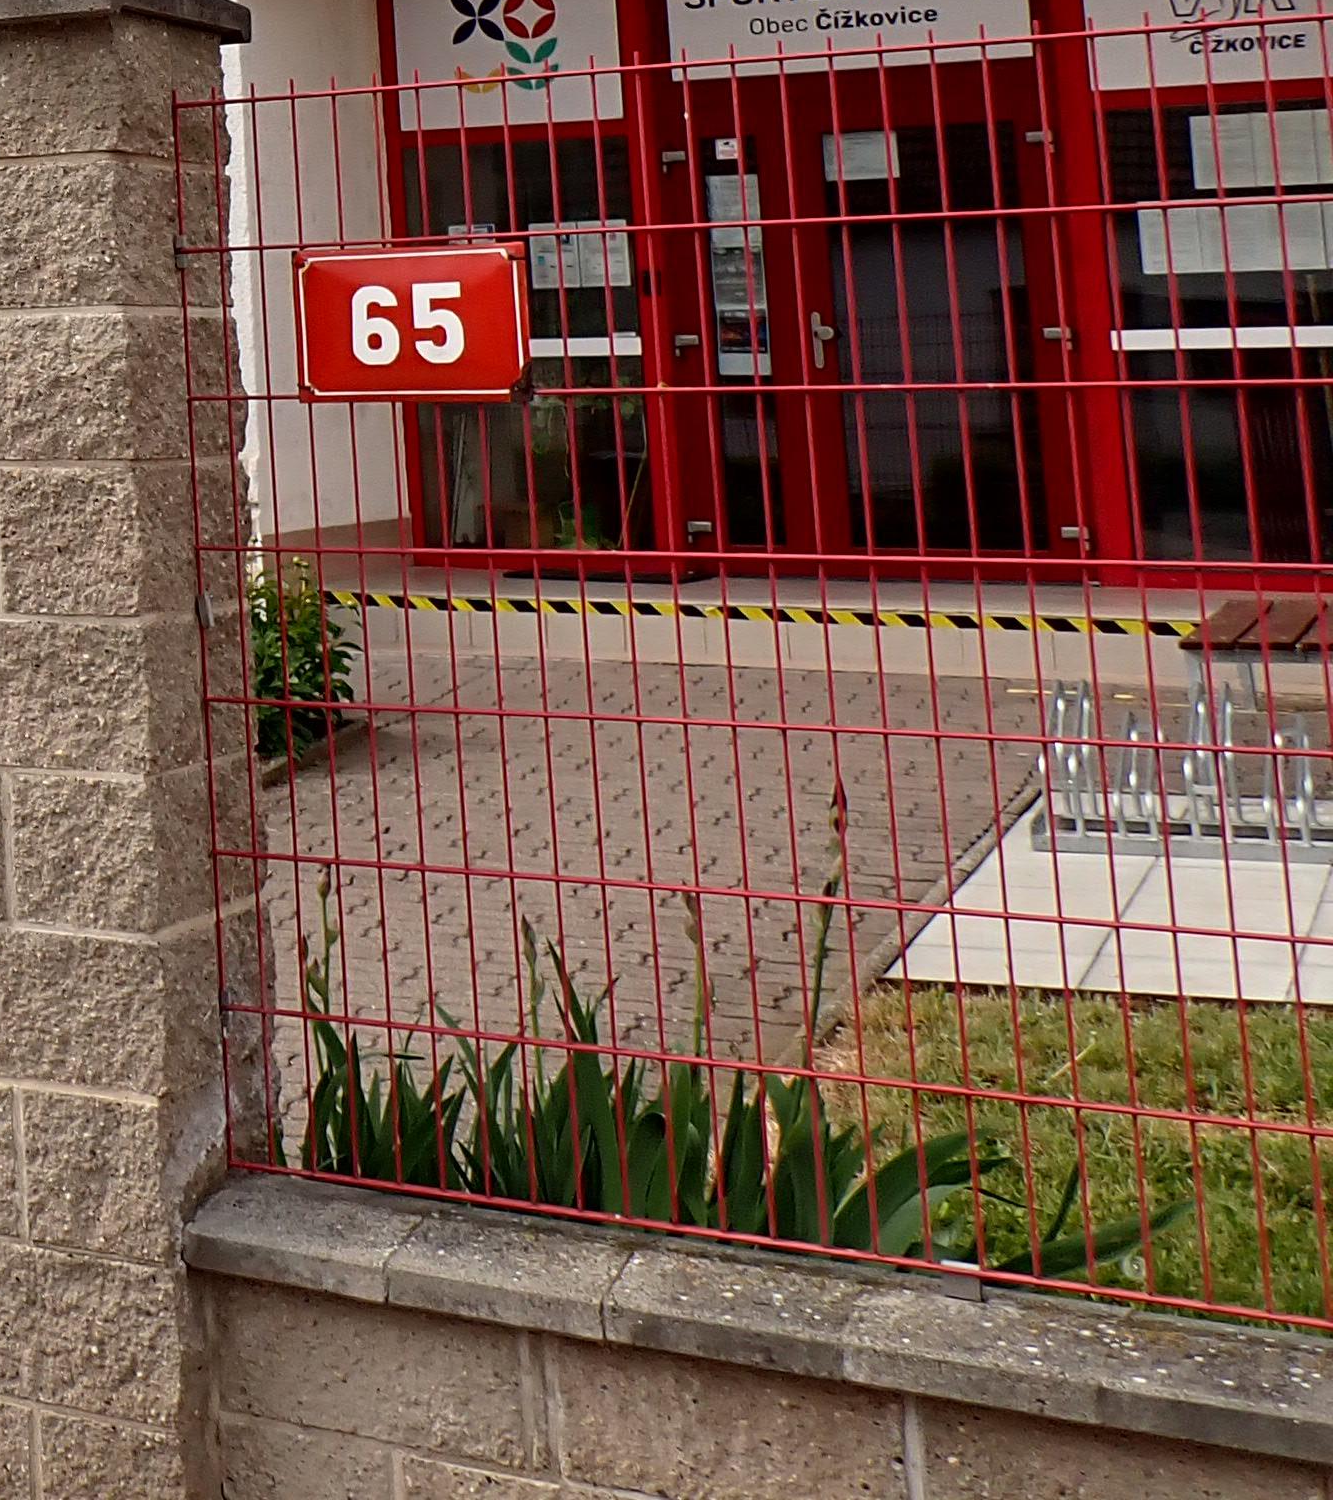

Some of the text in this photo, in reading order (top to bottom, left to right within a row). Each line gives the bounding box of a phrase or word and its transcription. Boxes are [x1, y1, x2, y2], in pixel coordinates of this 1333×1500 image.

[749, 5, 939, 35] Obec Čížkovice
[1189, 33, 1307, 55] ČŽKOVICE
[351, 281, 465, 366] 65
